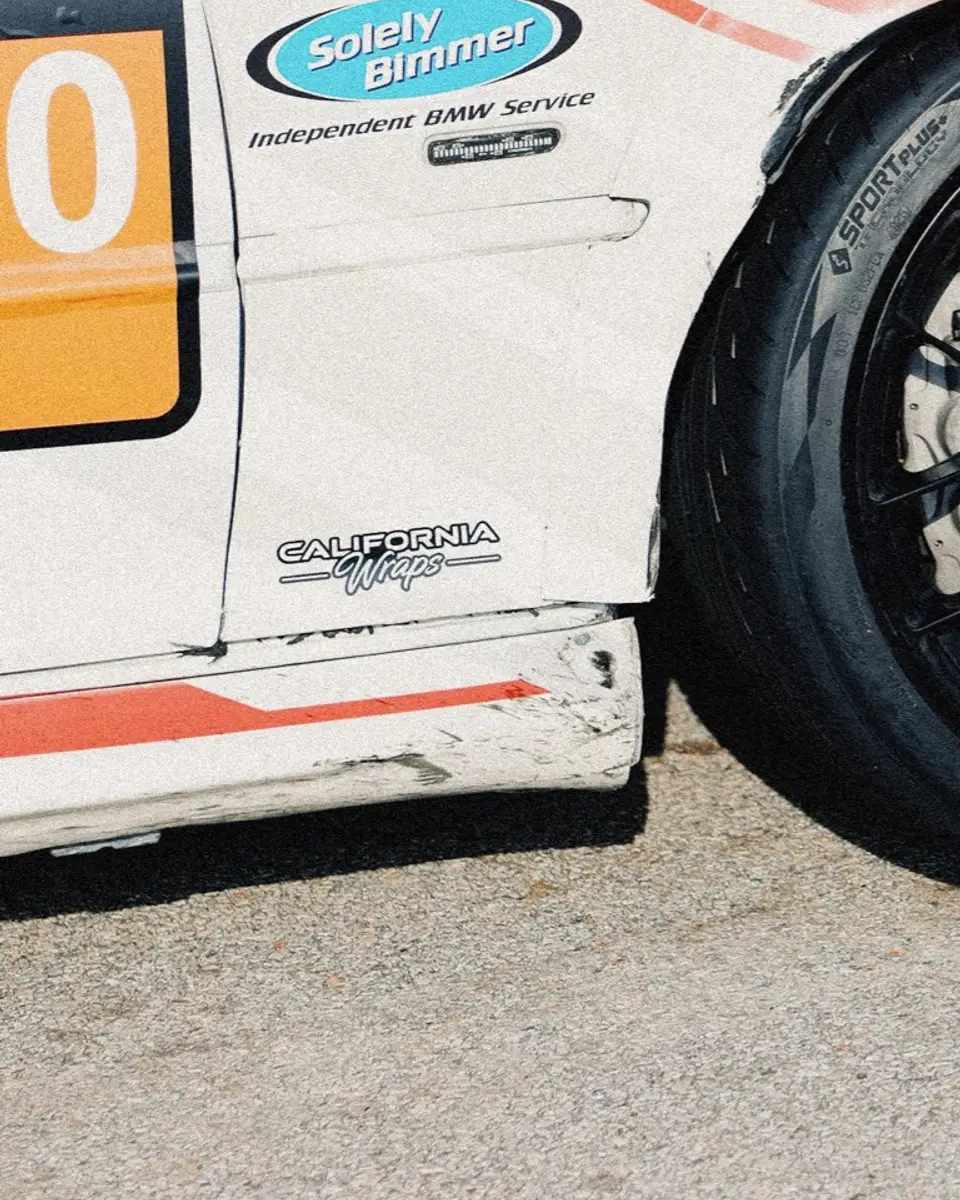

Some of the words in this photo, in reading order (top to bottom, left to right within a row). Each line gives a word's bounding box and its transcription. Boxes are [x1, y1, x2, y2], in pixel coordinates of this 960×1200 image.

[307, 8, 443, 71] Solely
[363, 16, 535, 91] Bimmer
[248, 115, 415, 149] Independent
[424, 102, 496, 128] BMW
[500, 91, 596, 117] Service
[6, 49, 138, 254] 0
[277, 520, 500, 564] CALIFORNIA
[332, 550, 444, 596] Wraps
